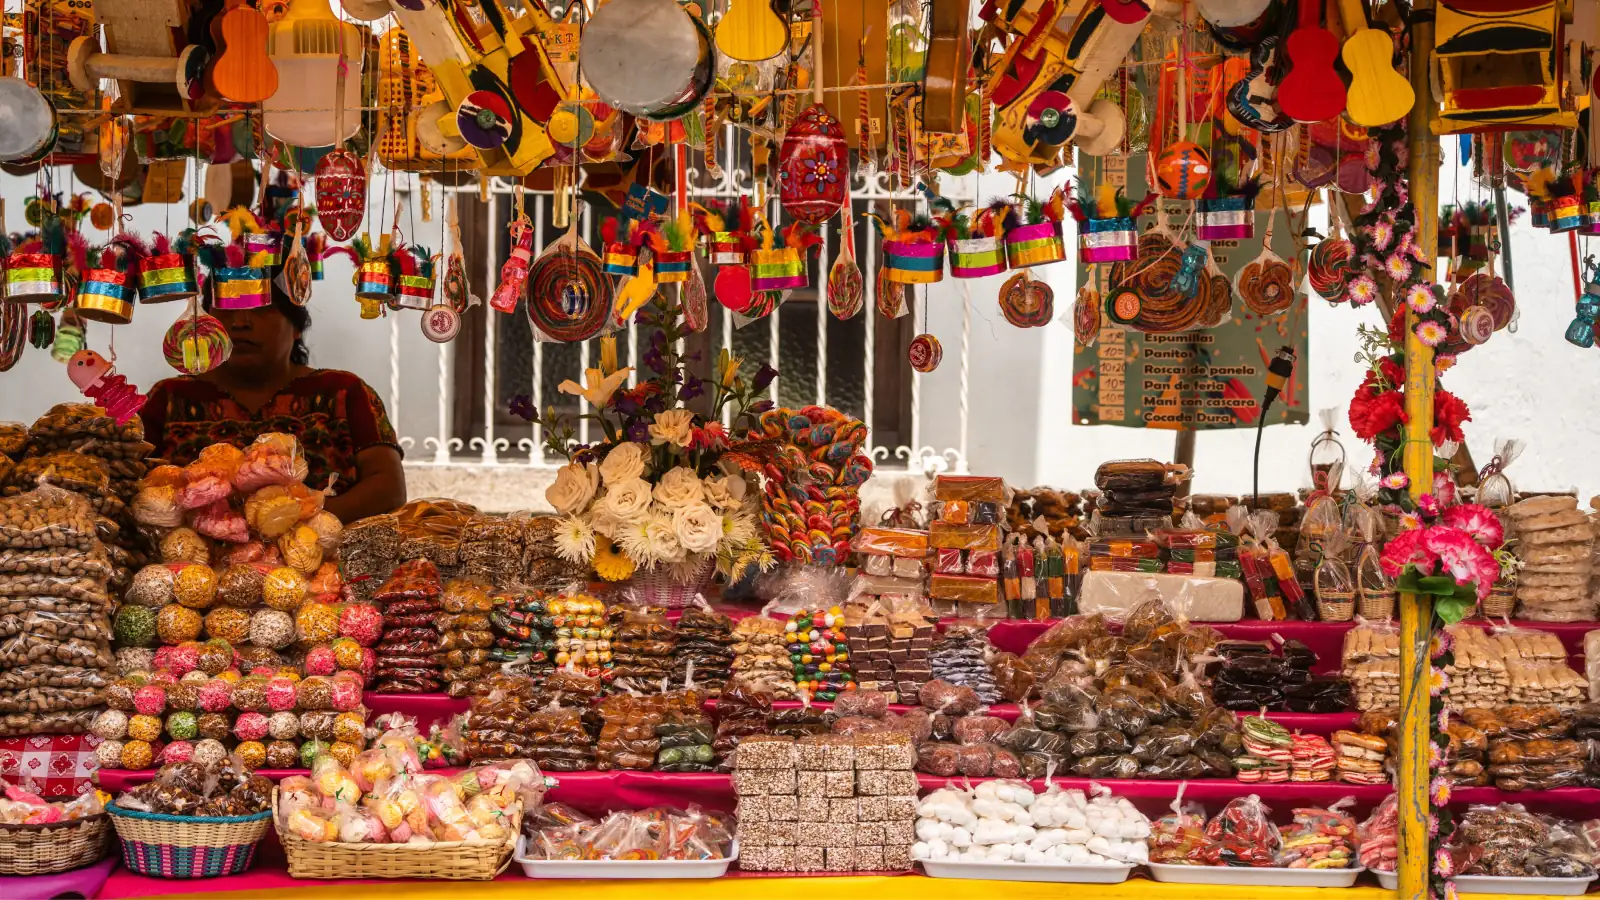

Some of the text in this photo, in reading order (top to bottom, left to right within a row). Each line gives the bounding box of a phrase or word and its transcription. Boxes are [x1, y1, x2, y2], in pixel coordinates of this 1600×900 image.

[1144, 333, 1213, 344] Espumillas
[1144, 349, 1194, 358] Panitos
[1144, 365, 1255, 377] Roscas de panela
[1144, 381, 1225, 391] Pan de feria
[1144, 413, 1230, 422] Cocada Dura
